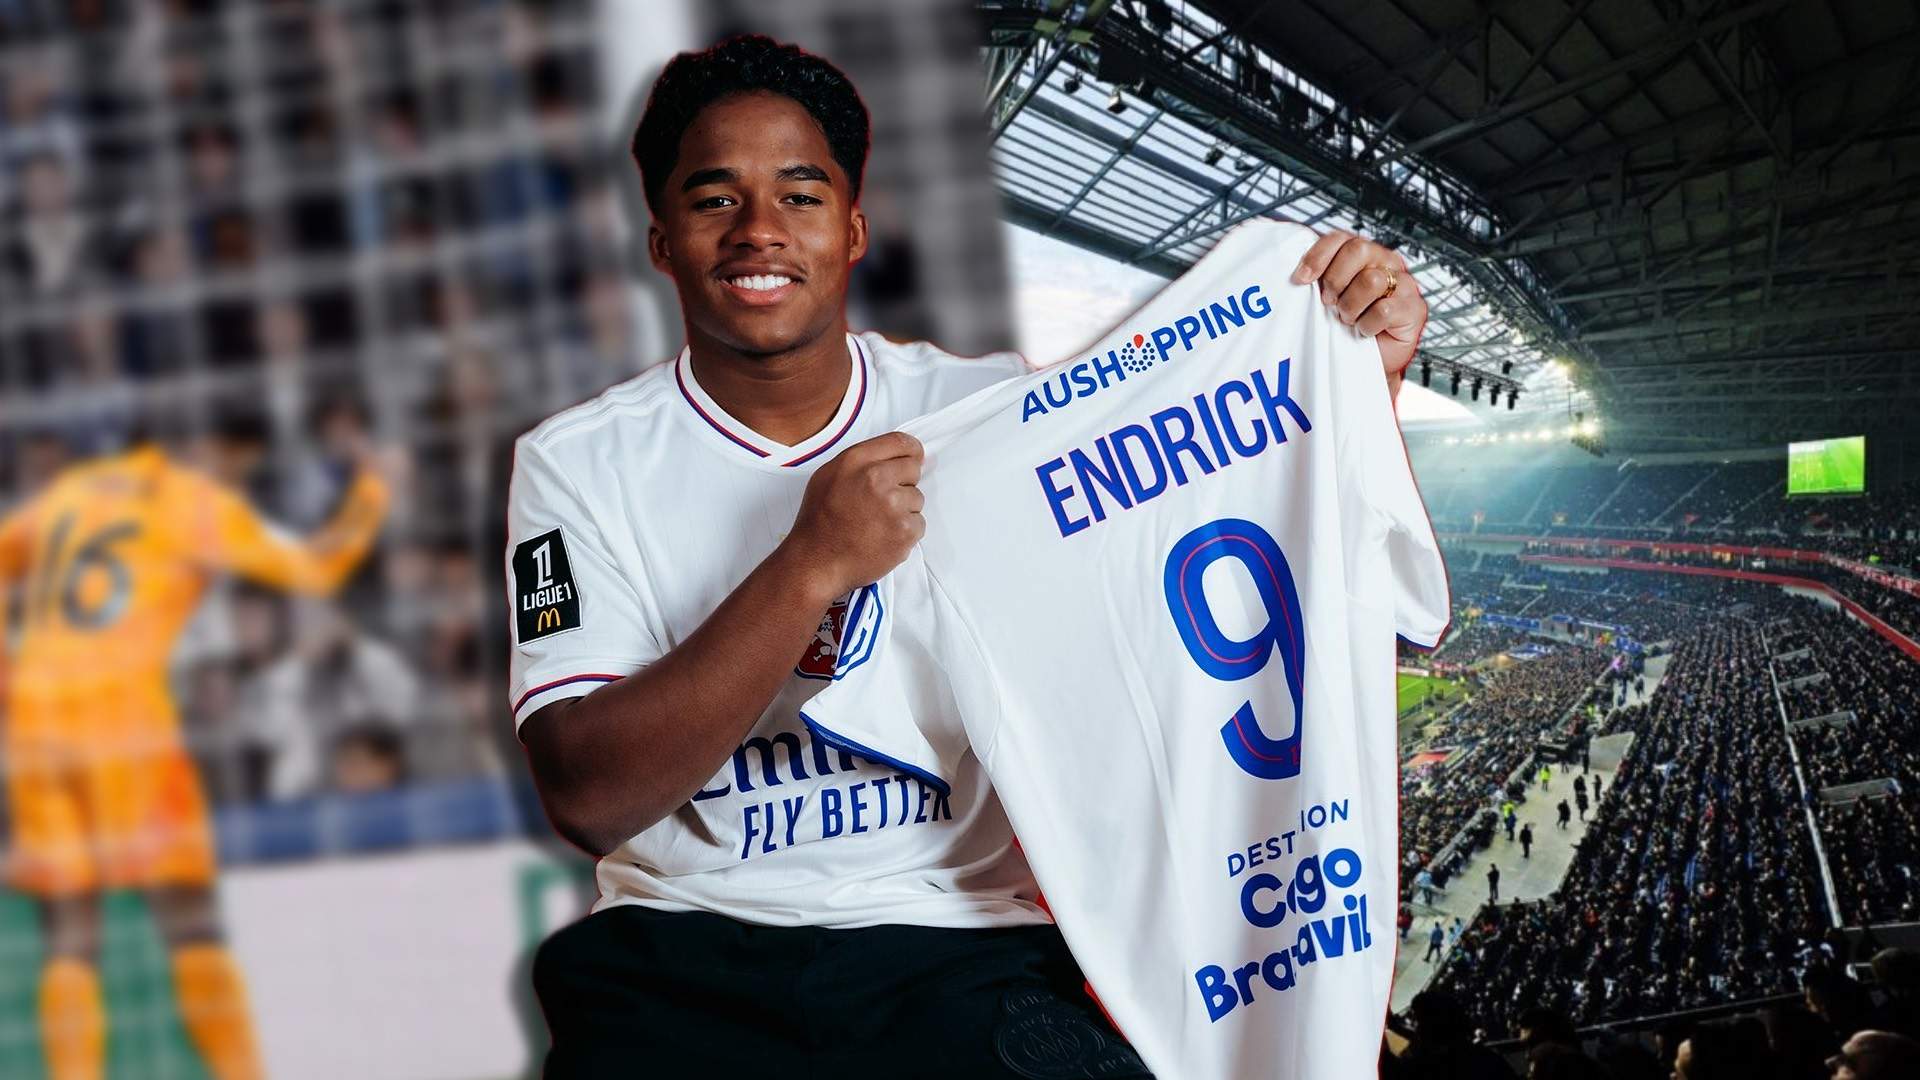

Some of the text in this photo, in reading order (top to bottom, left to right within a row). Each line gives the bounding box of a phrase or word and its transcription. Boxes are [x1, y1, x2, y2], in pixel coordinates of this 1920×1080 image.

[1022, 285, 1272, 423] AUSHOPPING
[1036, 358, 1312, 538] ENDRICK
[1163, 518, 1305, 779] 9
[742, 774, 952, 859] FLY BETTER
